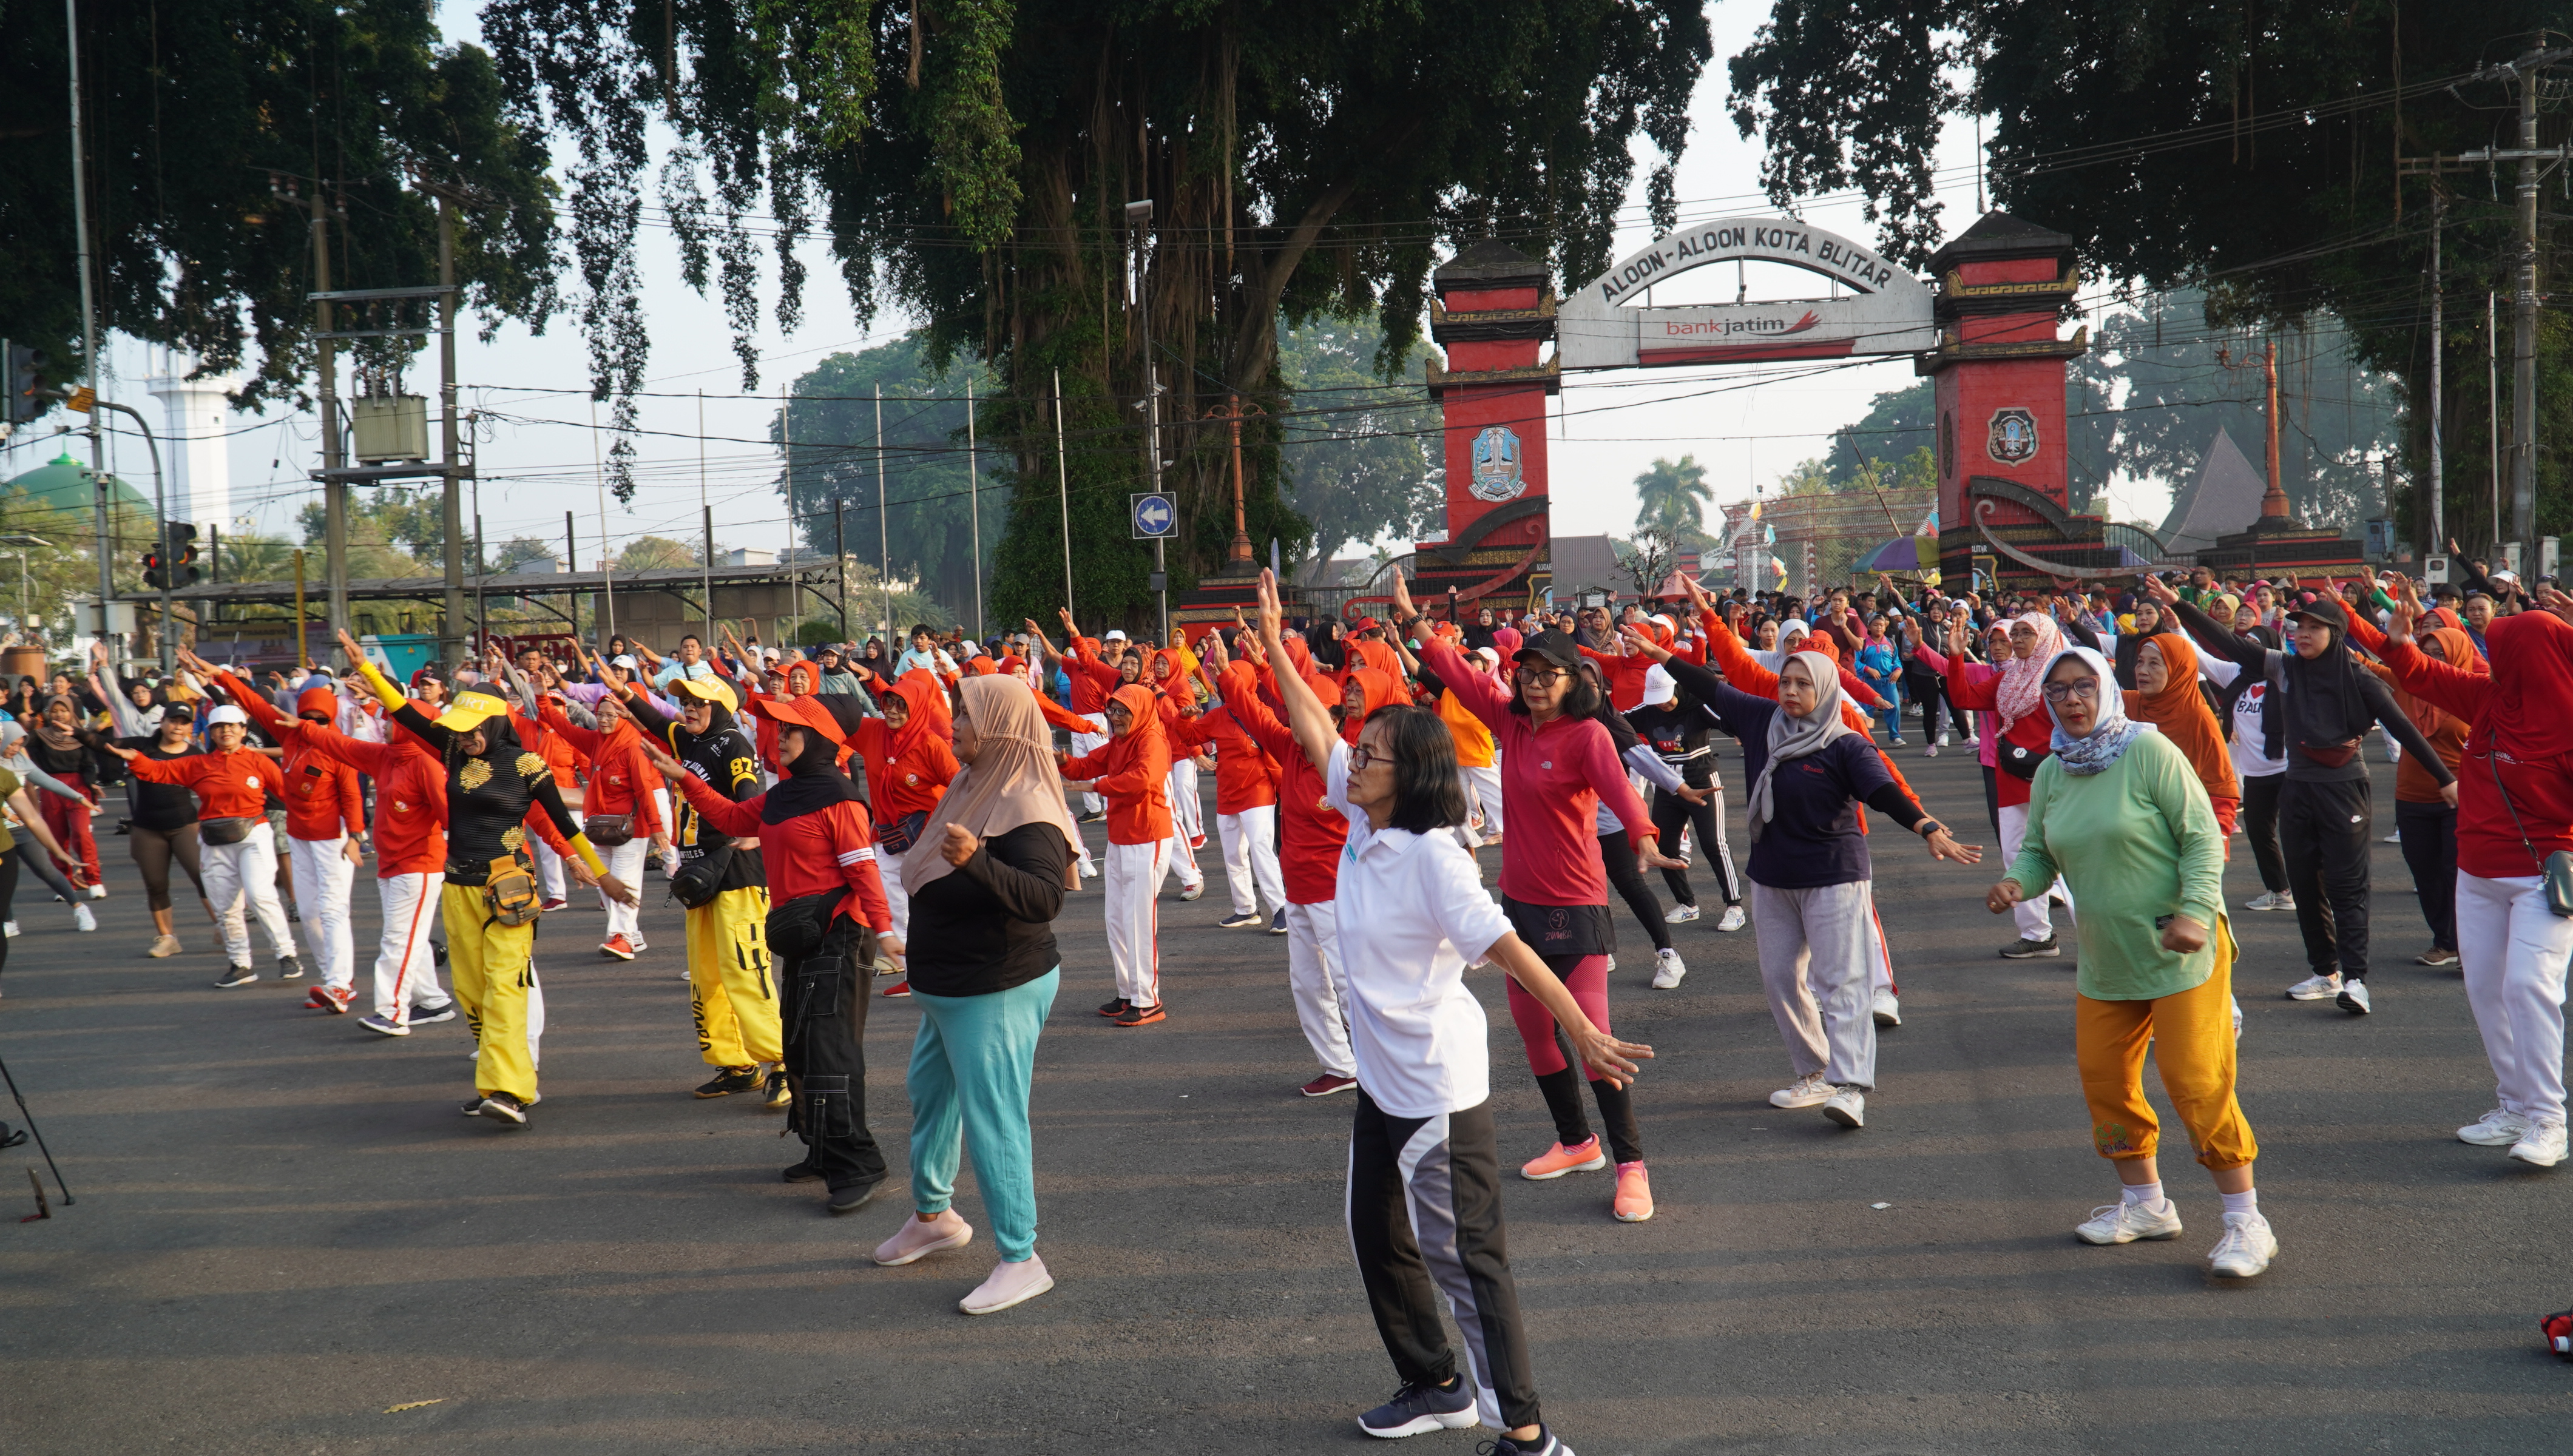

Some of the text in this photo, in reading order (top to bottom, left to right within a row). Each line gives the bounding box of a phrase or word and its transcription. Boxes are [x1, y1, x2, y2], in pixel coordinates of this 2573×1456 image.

[1601, 227, 1893, 303] ALOON-ALOON KOTA BLITAR
[1797, 640, 1836, 656] SPORT
[730, 757, 753, 777] 87
[1545, 929, 1572, 941] ZUMBA
